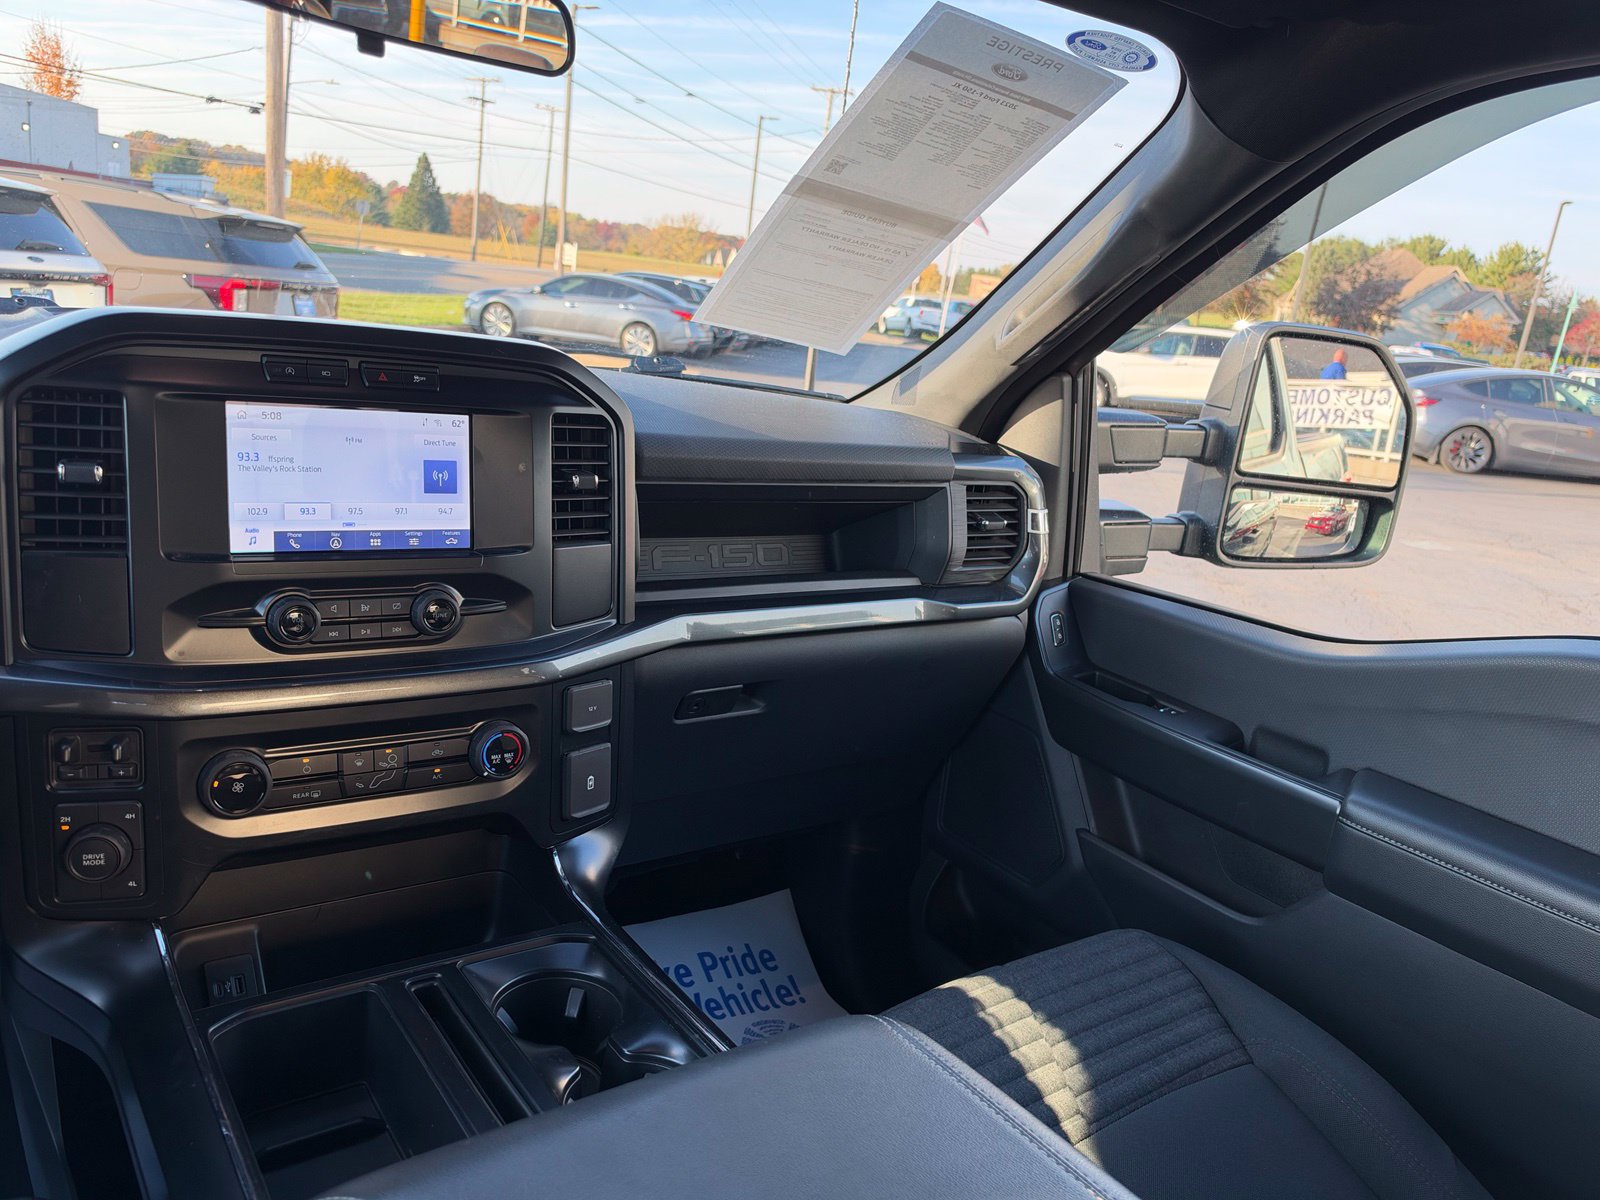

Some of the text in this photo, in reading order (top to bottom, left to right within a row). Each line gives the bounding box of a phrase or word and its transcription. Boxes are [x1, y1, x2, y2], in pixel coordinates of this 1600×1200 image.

[261, 411, 282, 420] 5:08
[251, 433, 277, 441] Sources
[237, 452, 260, 462] 93.3
[252, 465, 278, 473] Valley's
[247, 507, 268, 516] 102.9
[299, 507, 316, 516] 93.3
[348, 507, 363, 515] 97.5
[395, 507, 408, 515] 97.1
[438, 507, 453, 515] 94.7
[651, 542, 790, 571] F-150
[663, 942, 779, 987] e Pride
